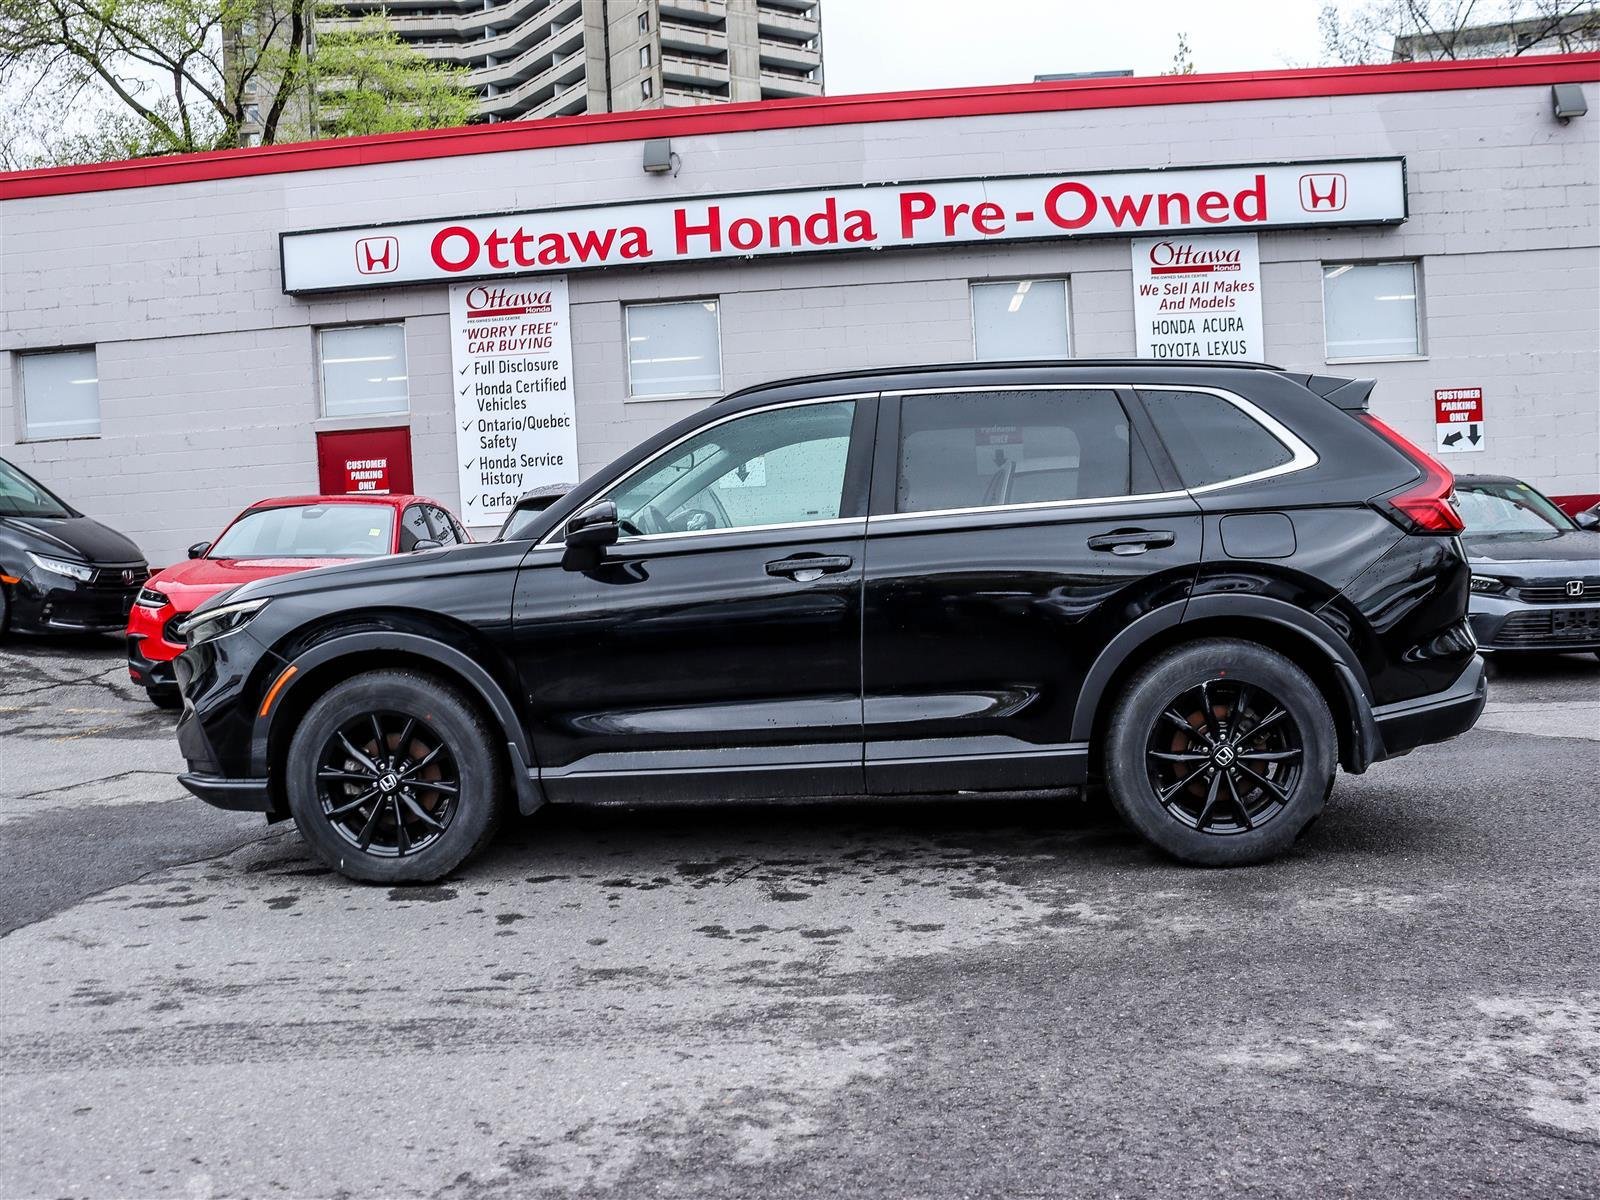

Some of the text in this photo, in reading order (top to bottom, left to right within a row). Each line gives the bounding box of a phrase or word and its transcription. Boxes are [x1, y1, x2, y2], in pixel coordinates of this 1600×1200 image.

[430, 174, 1267, 272] Ottawa Honda Pre-Owned
[1150, 241, 1241, 265] Ottawa
[1213, 264, 1241, 272] Honda
[1140, 280, 1255, 296] We Sell All Makes
[466, 286, 552, 309] Ottawa
[1160, 296, 1236, 310] And Models
[525, 305, 552, 314] Honda
[1152, 317, 1244, 335] HONDA ACURA
[468, 337, 553, 353] CAR BUYING
[1151, 340, 1247, 358] TOYOTA LEXUS
[474, 358, 559, 375] Full Disclosure
[475, 377, 567, 396] Honda Certified
[1436, 389, 1480, 400] CUSTOMER
[477, 396, 527, 412] Vehicles
[1441, 400, 1477, 411] PARKING
[478, 414, 570, 432] Ontario/Quebec
[1449, 412, 1469, 422] ONLY
[480, 434, 517, 452] Safety
[346, 459, 387, 470] CUSTOMER
[479, 453, 563, 470] Honda Service
[350, 470, 383, 480] PARKING
[481, 471, 524, 488] History
[358, 481, 377, 491] ONLY
[482, 492, 518, 507] Carfax
